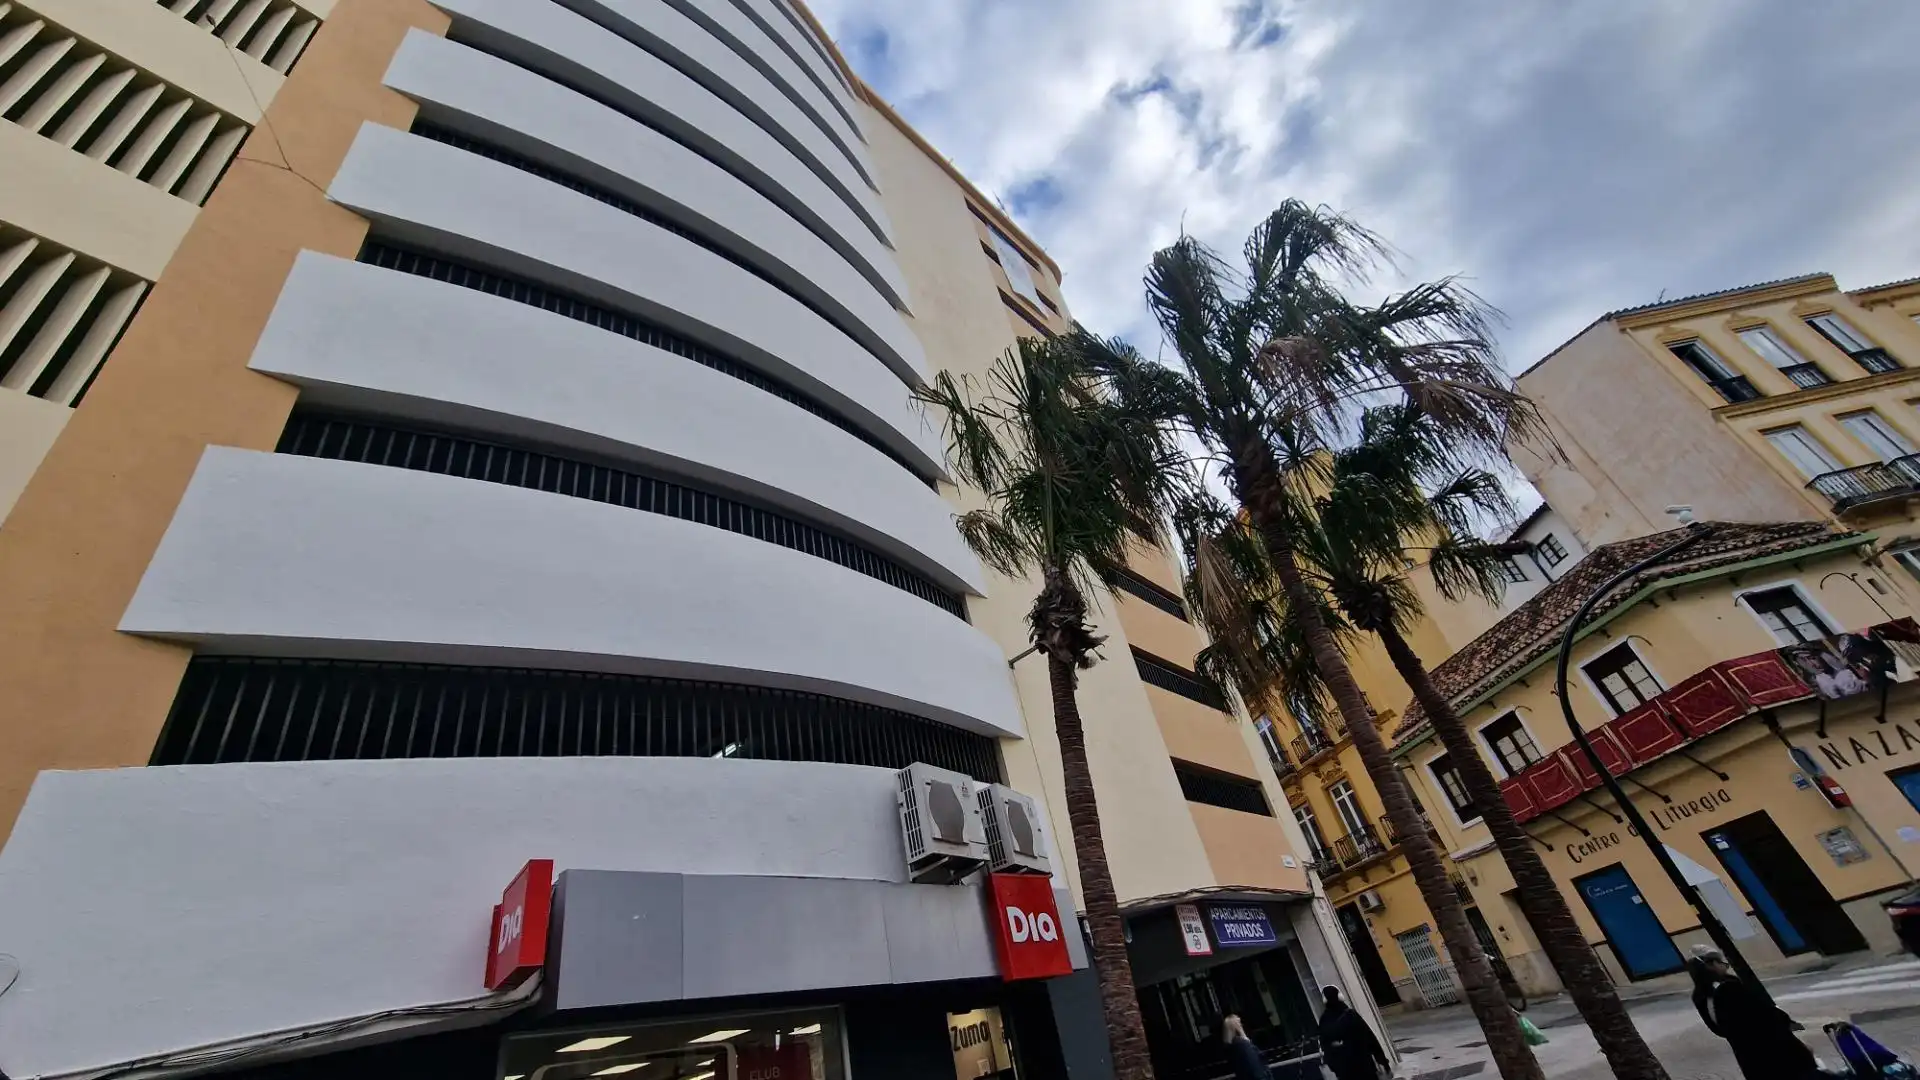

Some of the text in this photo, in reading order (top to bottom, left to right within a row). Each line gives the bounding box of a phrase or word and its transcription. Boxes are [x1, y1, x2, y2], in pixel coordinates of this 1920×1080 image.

[1818, 718, 1920, 770] NAZA
[1210, 907, 1266, 920] APARCAMIENTOS
[1224, 922, 1265, 938] PRIVADOS
[950, 1021, 989, 1051] Zumo
